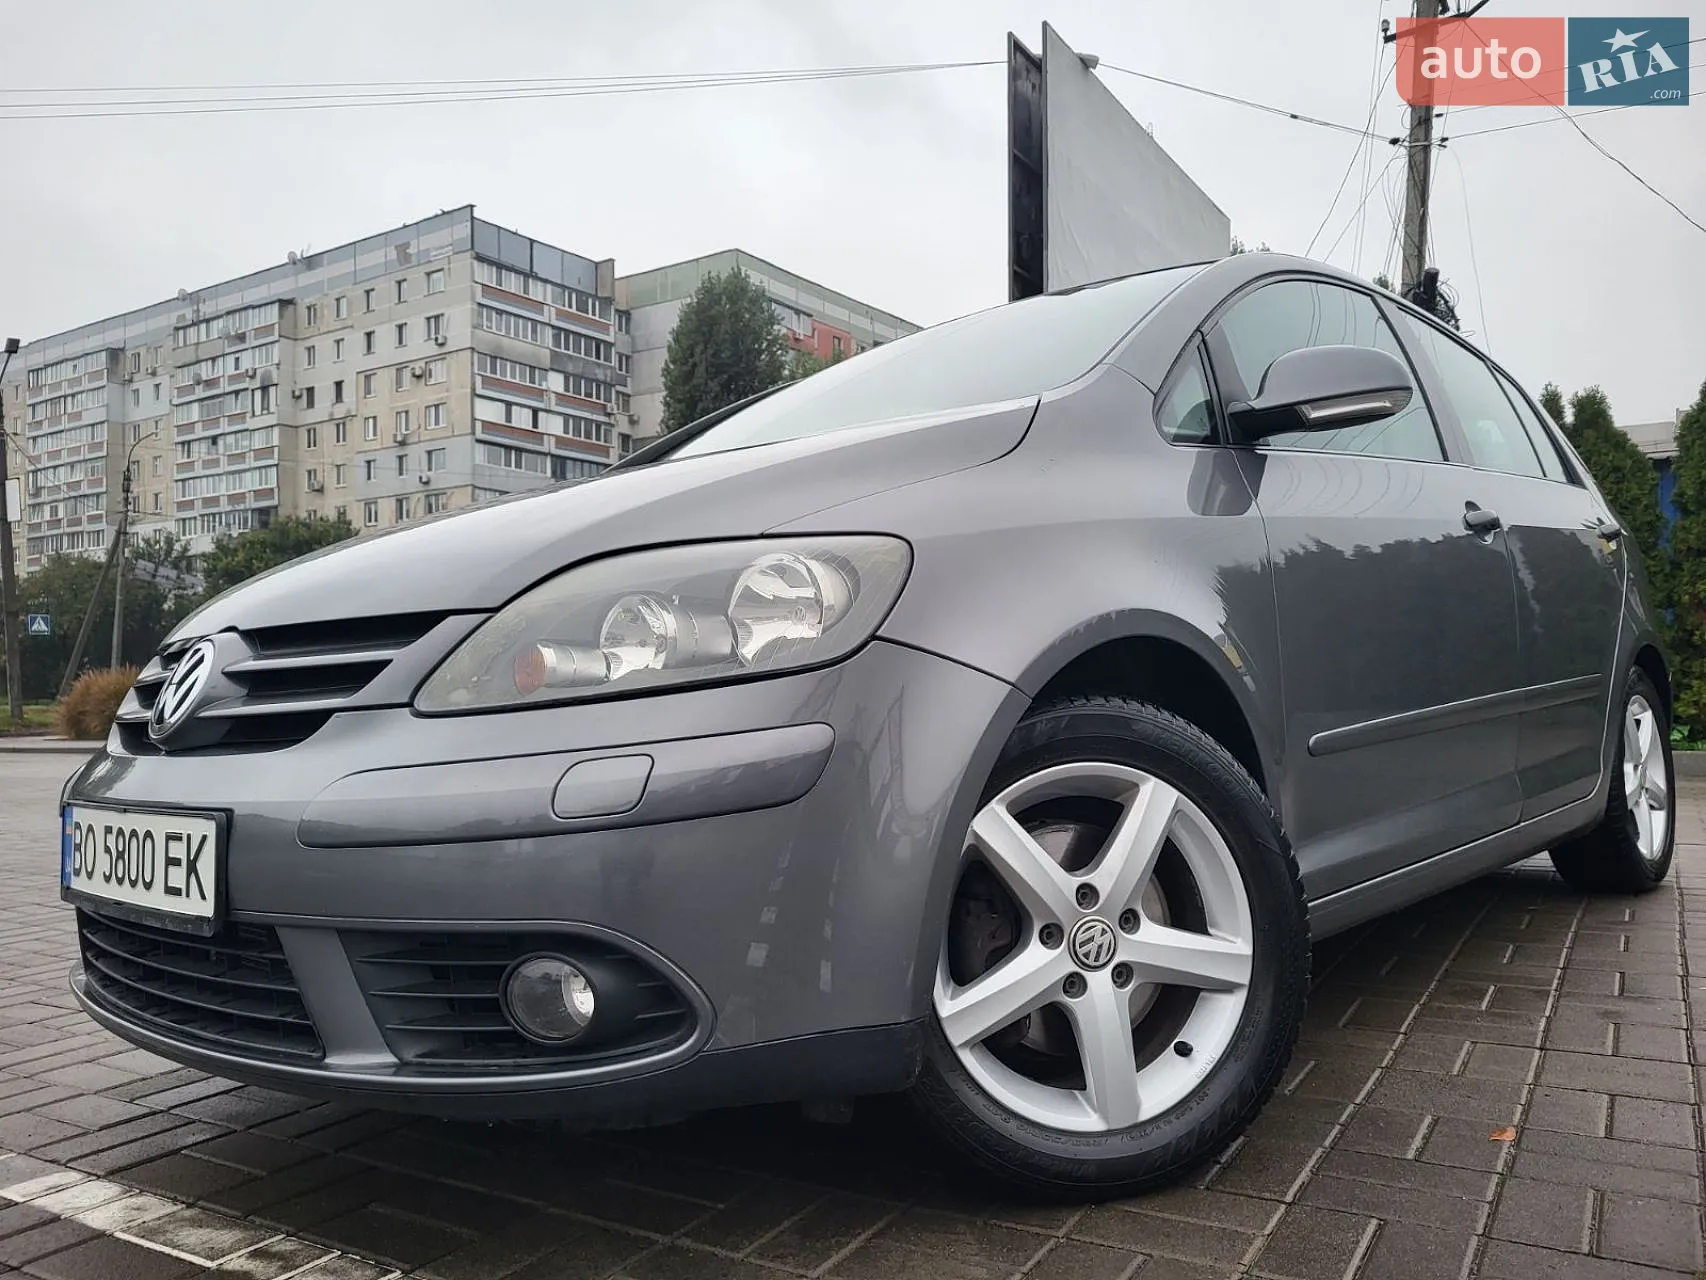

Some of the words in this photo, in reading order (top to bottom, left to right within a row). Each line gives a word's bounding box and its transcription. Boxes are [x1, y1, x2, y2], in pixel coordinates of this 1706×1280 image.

[73, 821, 97, 880] BO
[103, 824, 156, 891] 5800
[164, 831, 208, 901] EK
